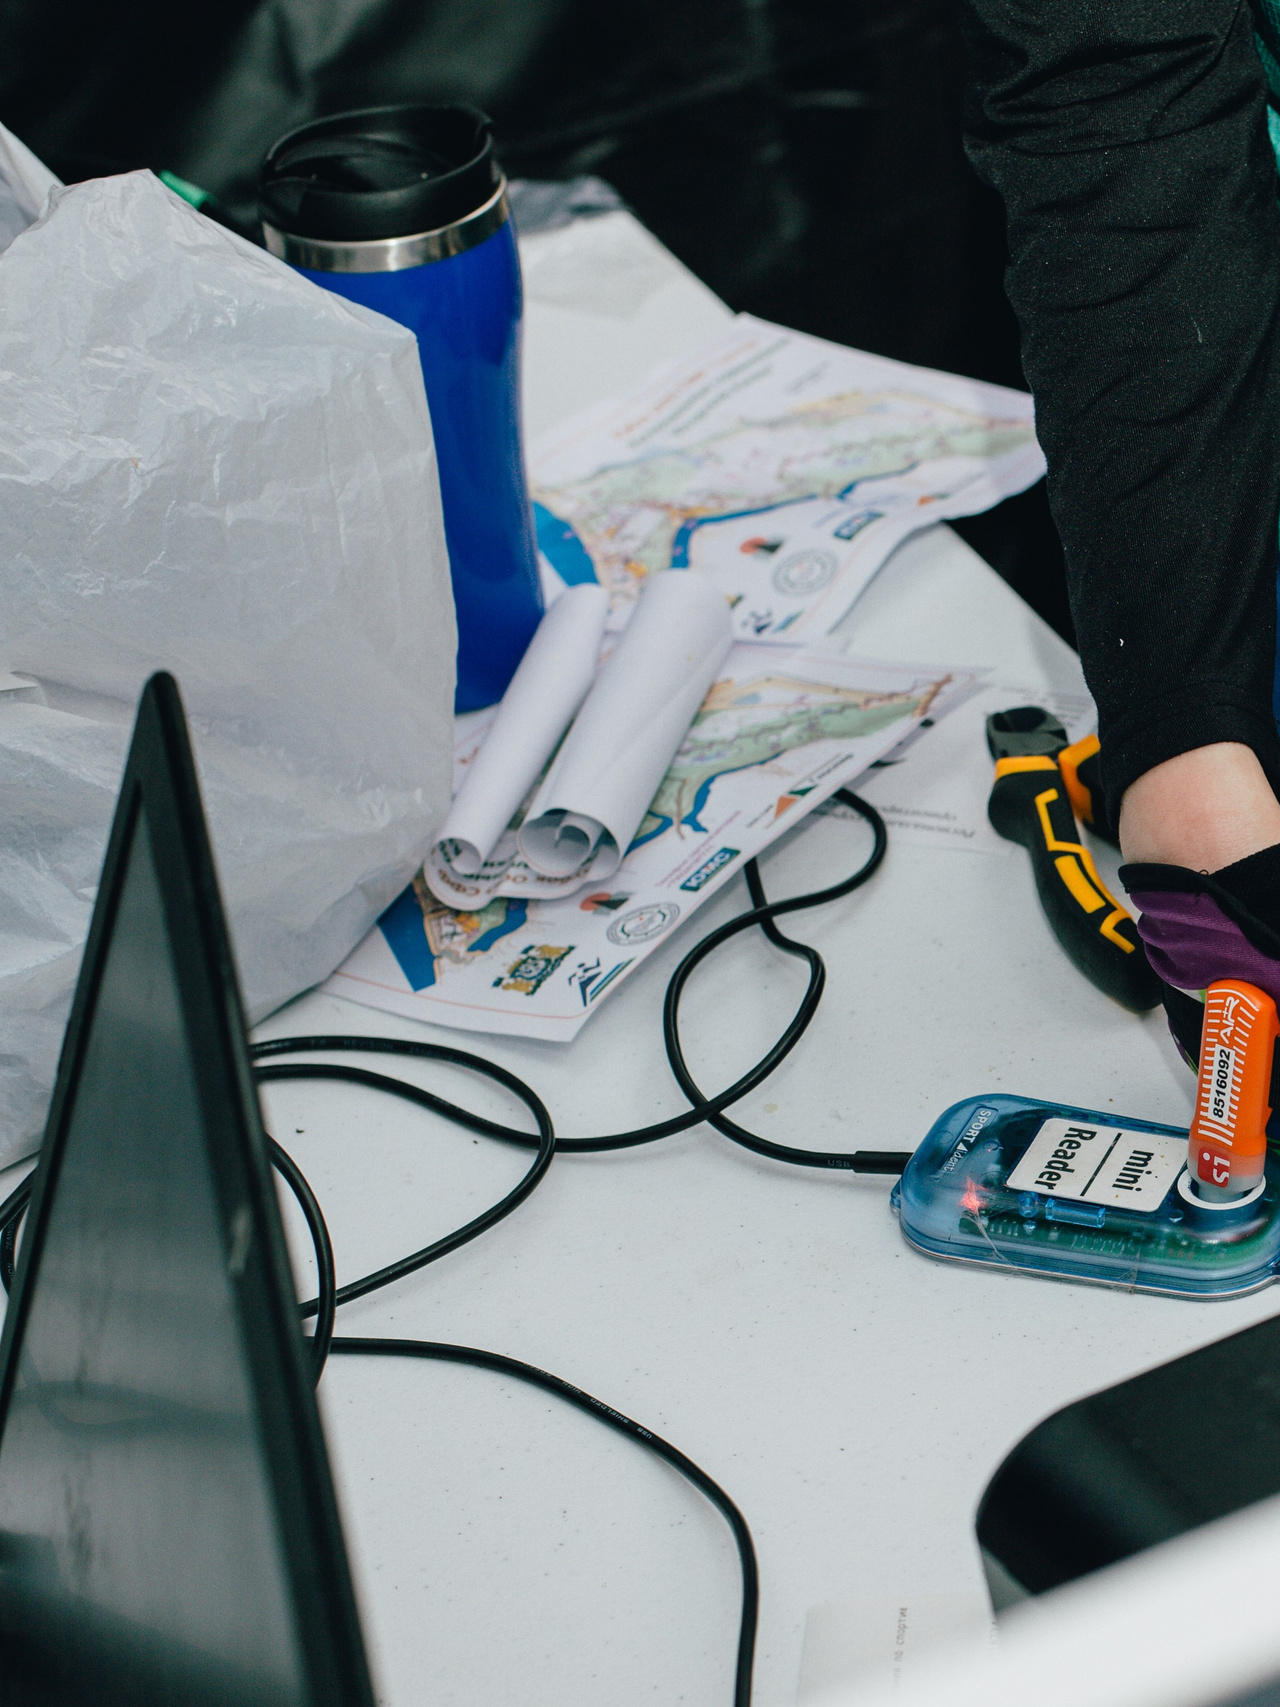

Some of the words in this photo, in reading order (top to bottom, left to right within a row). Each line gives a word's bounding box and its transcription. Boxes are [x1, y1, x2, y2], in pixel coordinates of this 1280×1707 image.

[1213, 1049, 1231, 1119] 8516092
[962, 1110, 991, 1143] SPORT
[827, 1159, 851, 1169] USB
[1034, 1127, 1097, 1190] Reader
[1111, 1150, 1155, 1192] mini
[590, 1398, 630, 1425] SHIELDED
[636, 1426, 653, 1439] USB
